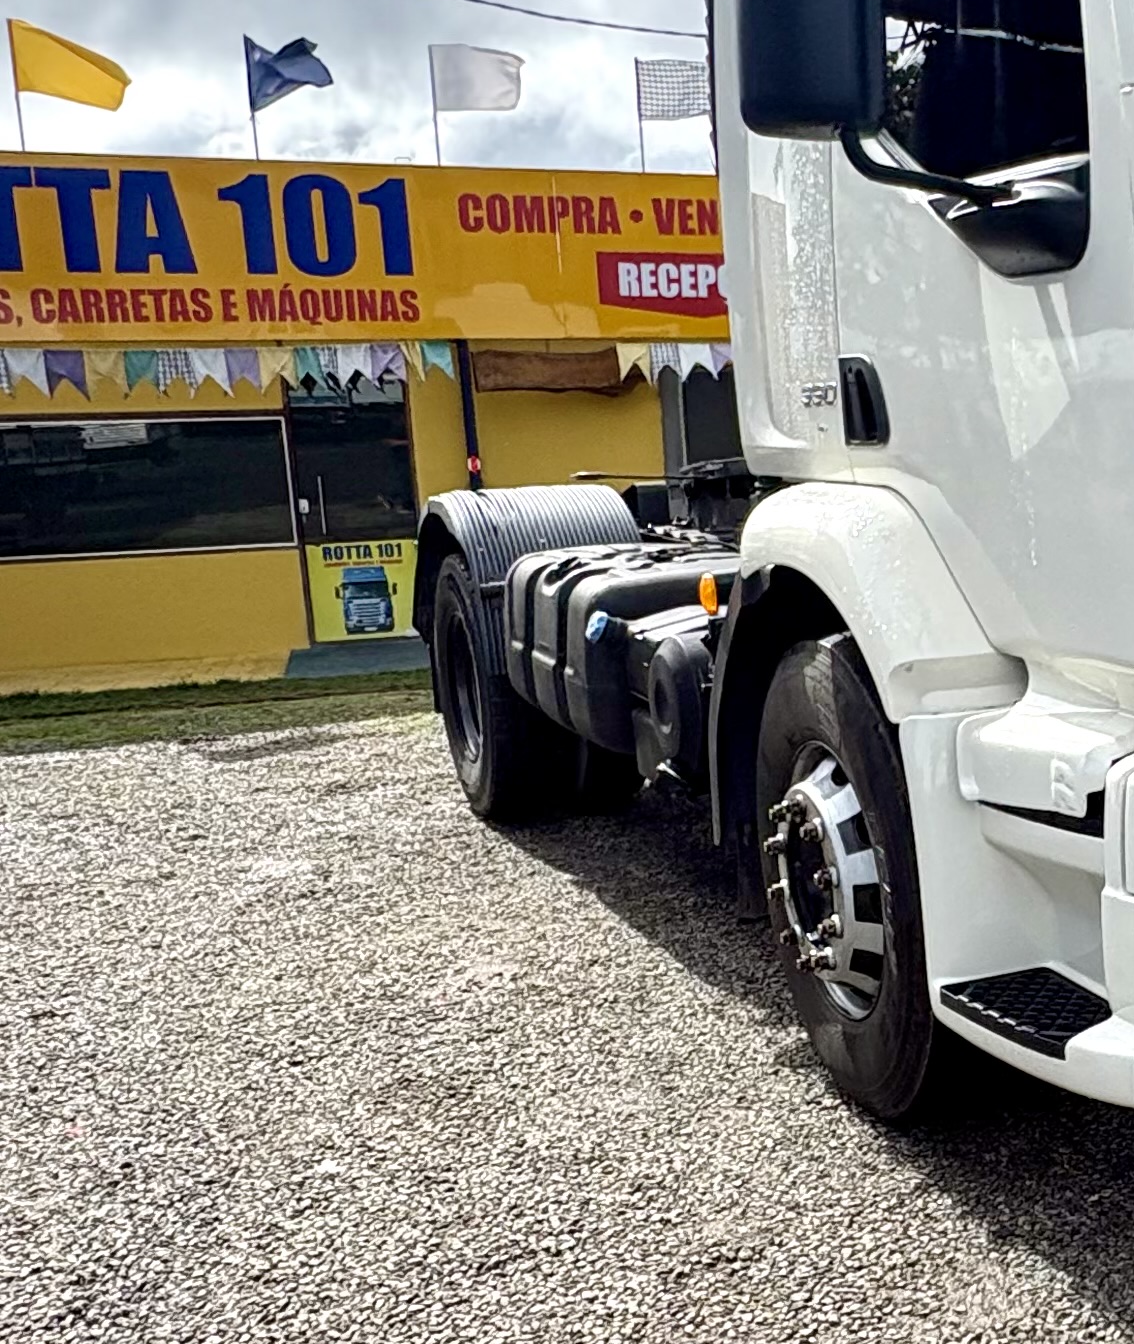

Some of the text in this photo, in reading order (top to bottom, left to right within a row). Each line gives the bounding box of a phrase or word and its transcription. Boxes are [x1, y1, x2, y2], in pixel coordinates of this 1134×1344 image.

[217, 174, 414, 276] 101
[457, 193, 621, 234] COMPRA
[30, 288, 214, 324] CARRETAS
[220, 288, 240, 322] E
[246, 283, 420, 325] MÁQUINAS
[322, 542, 403, 562] ROTTA 101
